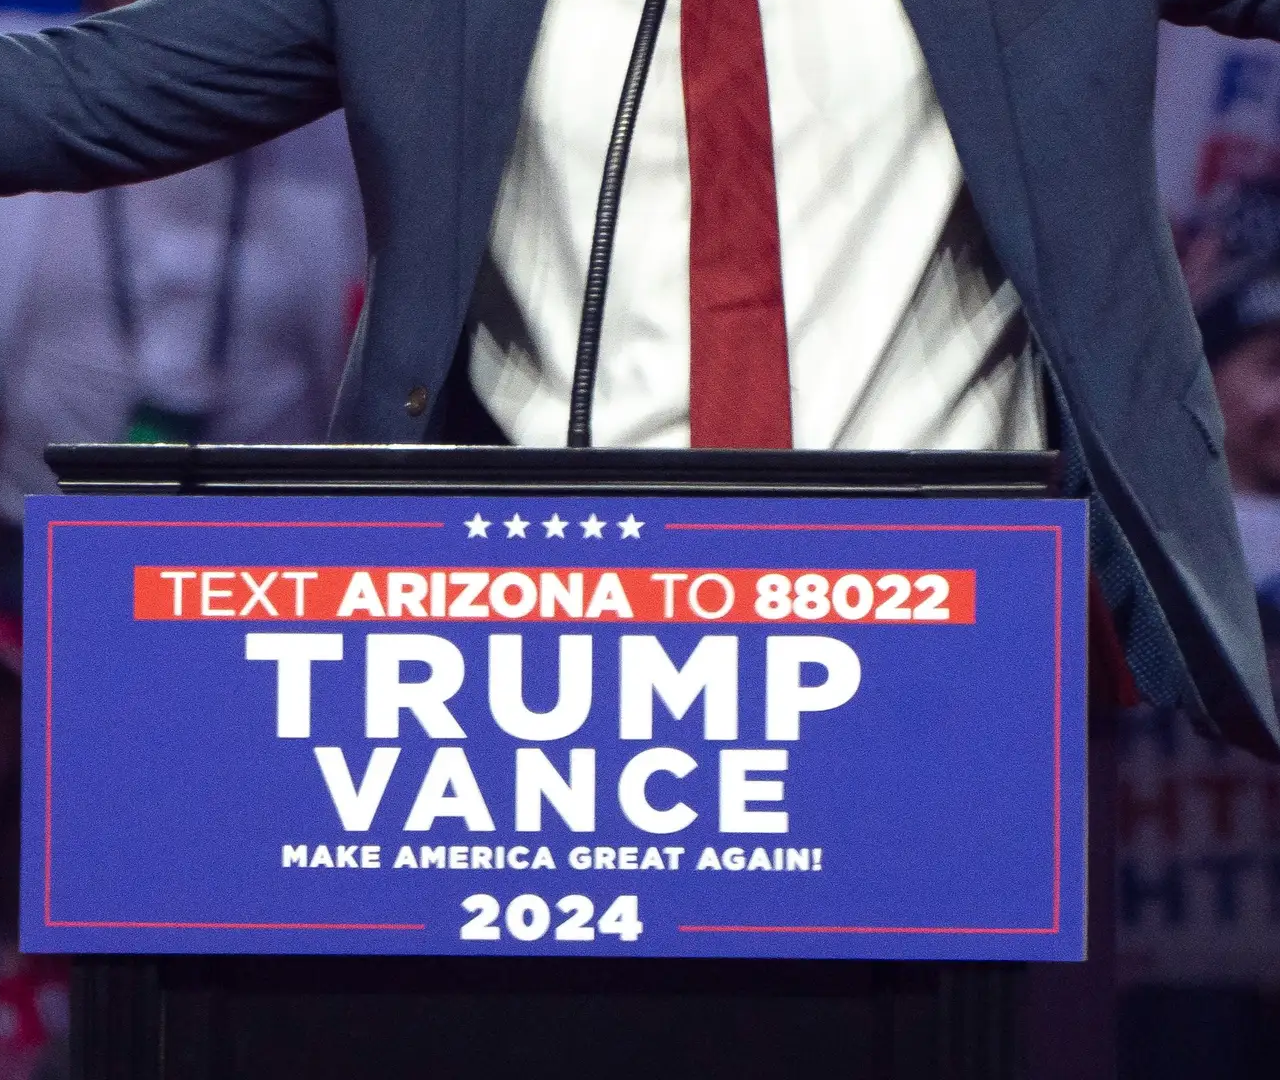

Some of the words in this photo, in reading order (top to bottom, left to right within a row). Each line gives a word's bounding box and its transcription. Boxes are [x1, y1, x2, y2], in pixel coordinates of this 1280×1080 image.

[160, 571, 319, 618] TEXT
[336, 571, 634, 619] ARIZONA
[651, 573, 736, 620] TO
[753, 573, 950, 621] 88022
[244, 632, 862, 742] TRUMP
[313, 746, 790, 835] VANCE
[281, 844, 381, 869] MAKE
[393, 845, 557, 870] AMERICA
[568, 845, 686, 871] GREAT
[696, 846, 822, 872] AGAIN!
[459, 893, 644, 942] 2024
